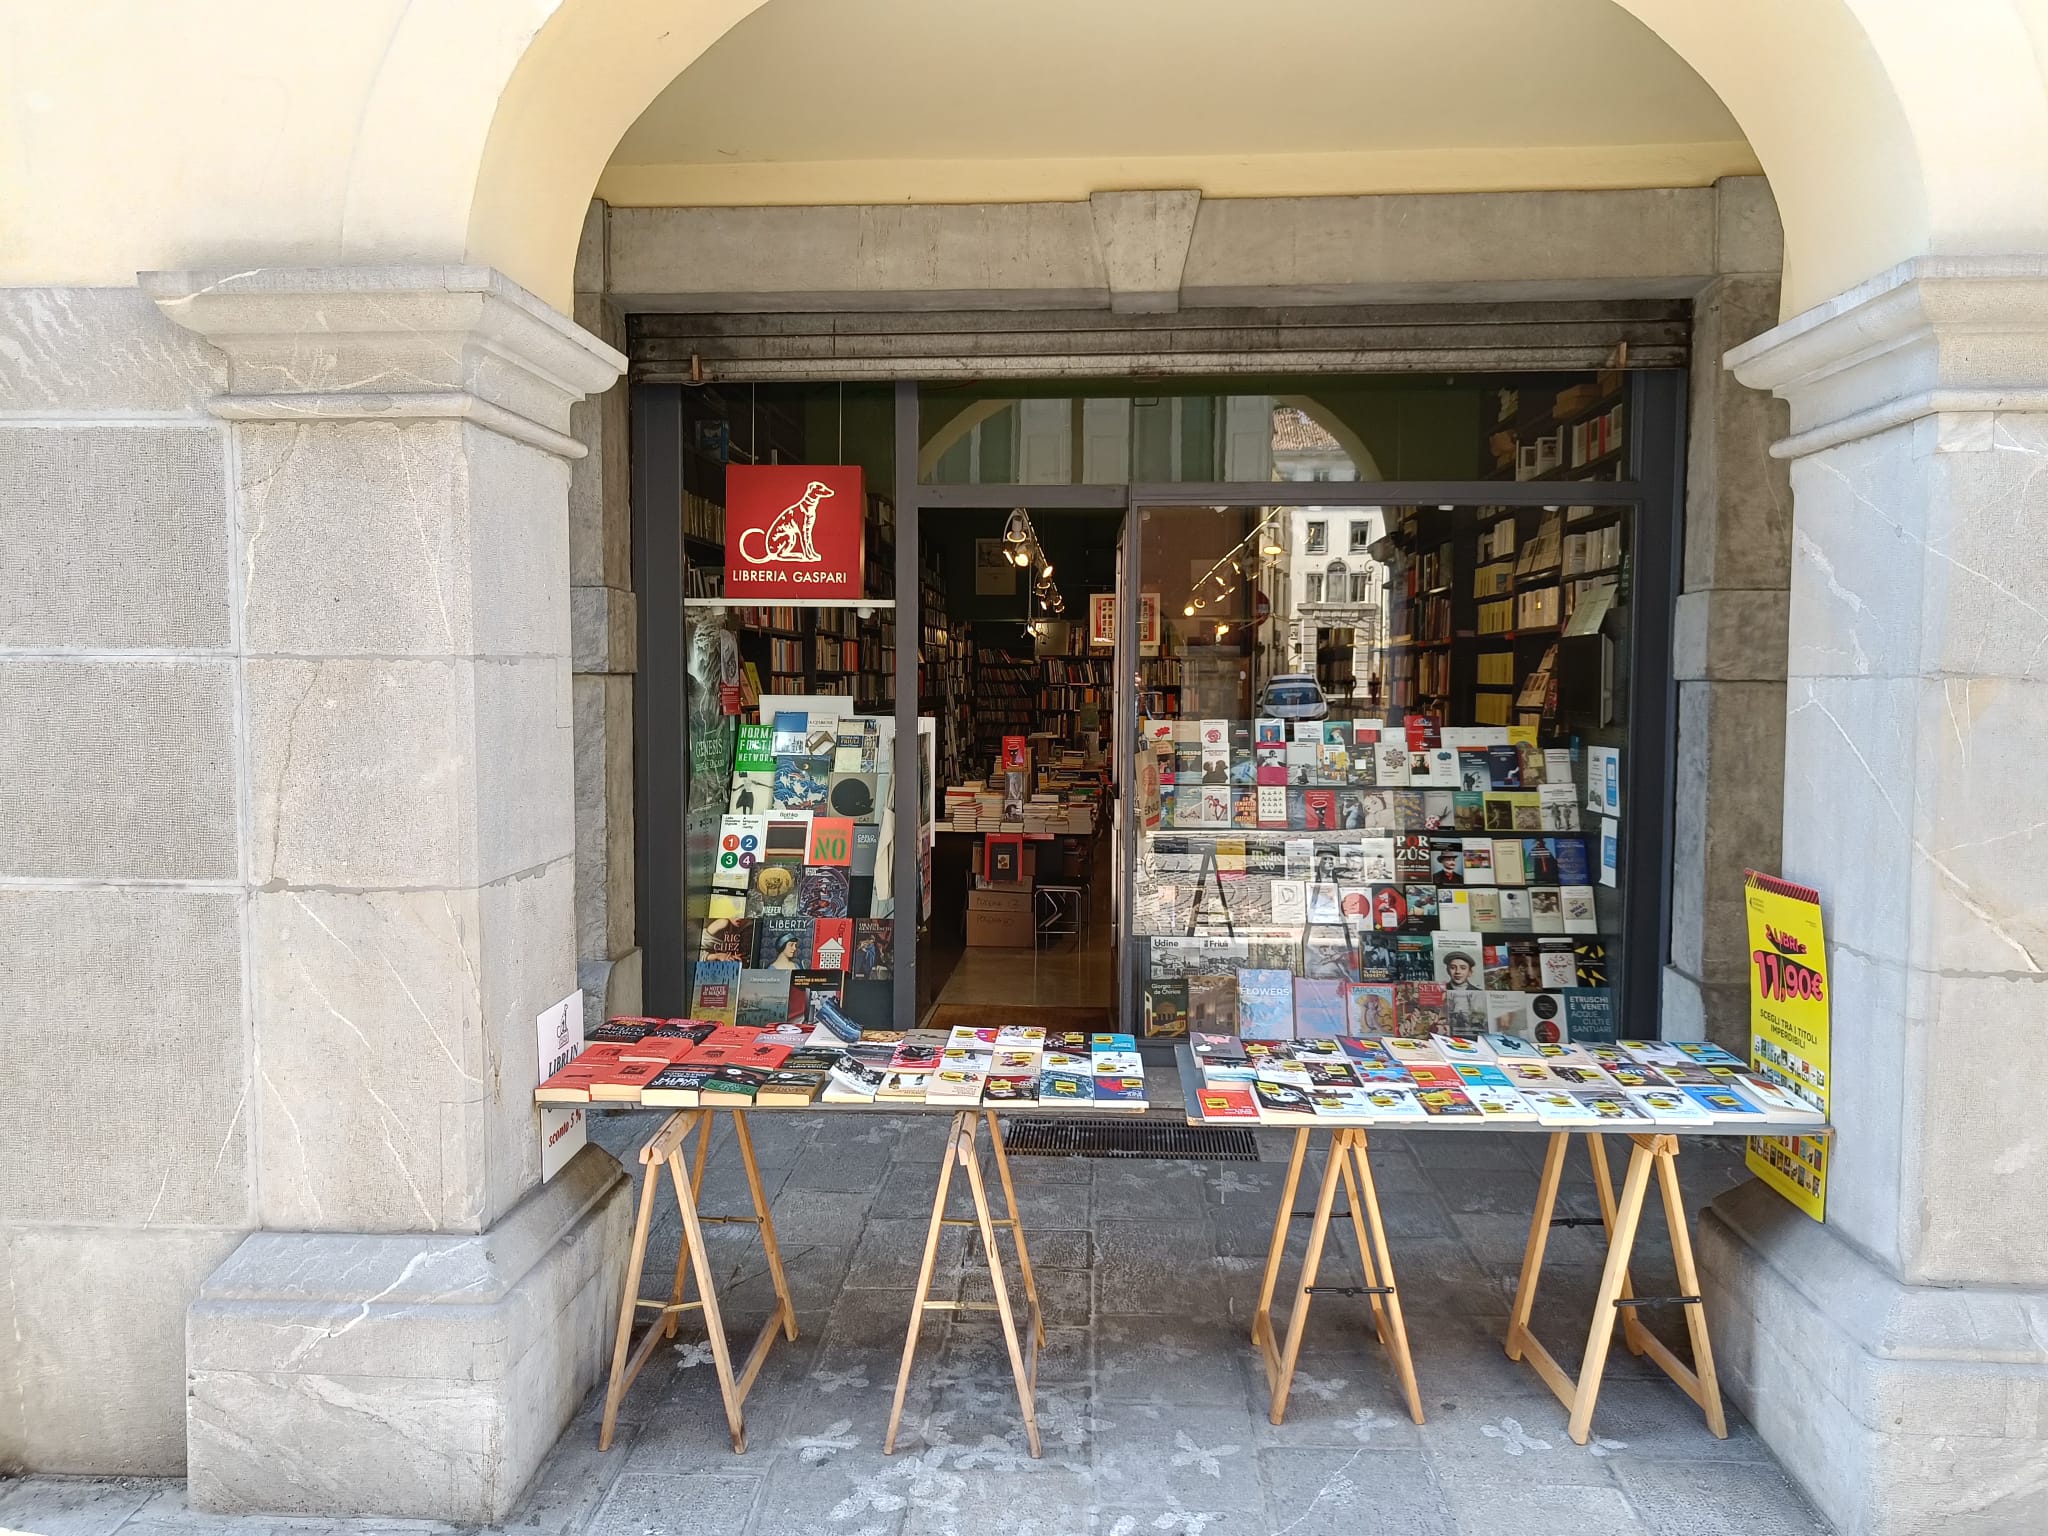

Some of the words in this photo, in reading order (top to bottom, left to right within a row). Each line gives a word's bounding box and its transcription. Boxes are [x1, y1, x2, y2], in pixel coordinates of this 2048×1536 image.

[732, 570, 788, 582] LIBRERIA
[793, 571, 847, 584] GASPARI
[695, 738, 723, 758] GENESIS
[728, 838, 734, 847] 1
[745, 838, 753, 848] 2
[814, 837, 847, 861] NO
[1396, 836, 1429, 848] POR
[725, 855, 733, 865] 3
[742, 855, 751, 865] 4
[769, 919, 807, 929] LIBERTY
[723, 934, 741, 943] RIC
[1153, 939, 1179, 948] Udine
[1765, 924, 1772, 939] 2
[1774, 928, 1799, 952] LIBRI
[1753, 950, 1823, 1002] 11,90€
[1240, 987, 1290, 996] FLOWERS
[1572, 1025, 1612, 1033] SANTUARI
[1760, 1009, 1780, 1027] SCEGLI
[1781, 1019, 1793, 1033] TRA
[1797, 1027, 1818, 1046] TITOLI
[1770, 1023, 1806, 1049] IMPERDIBILI
[548, 1049, 569, 1078] LIBRI
[548, 1121, 570, 1148] sconto
[570, 1112, 575, 1129] 5
[575, 1108, 582, 1124] %
